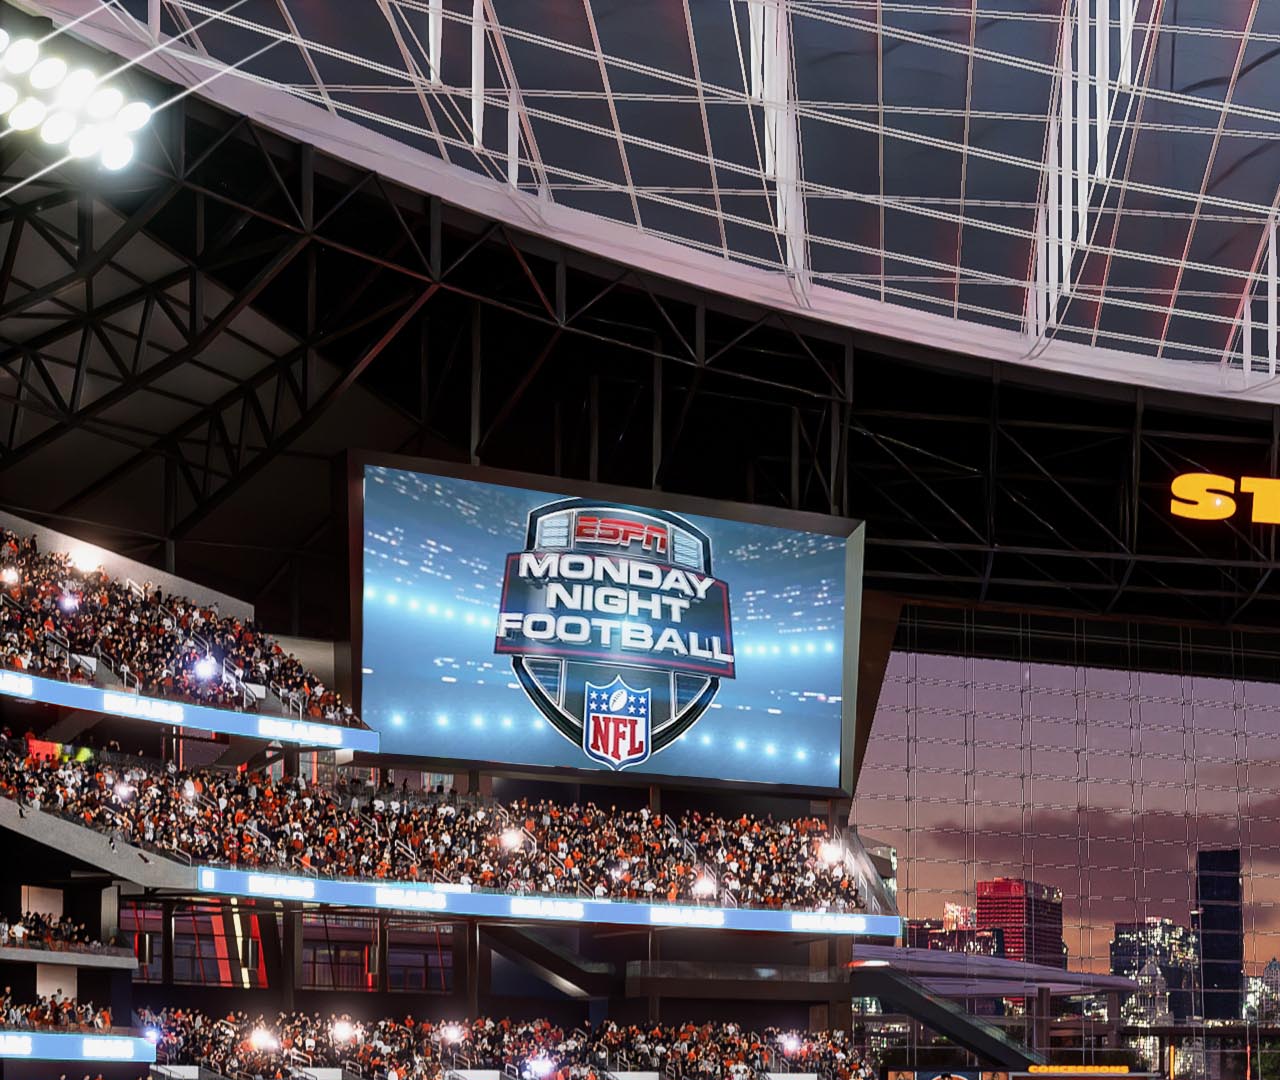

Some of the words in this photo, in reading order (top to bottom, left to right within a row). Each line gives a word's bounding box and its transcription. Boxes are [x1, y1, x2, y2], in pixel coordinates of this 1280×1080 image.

[575, 516, 669, 553] ESPN
[518, 553, 716, 600] MONDAY
[546, 582, 691, 623] NIGHT
[496, 612, 735, 663] FOOTBALL
[590, 715, 644, 760] NFL
[1028, 1064, 1130, 1074] CONCESSIONS
